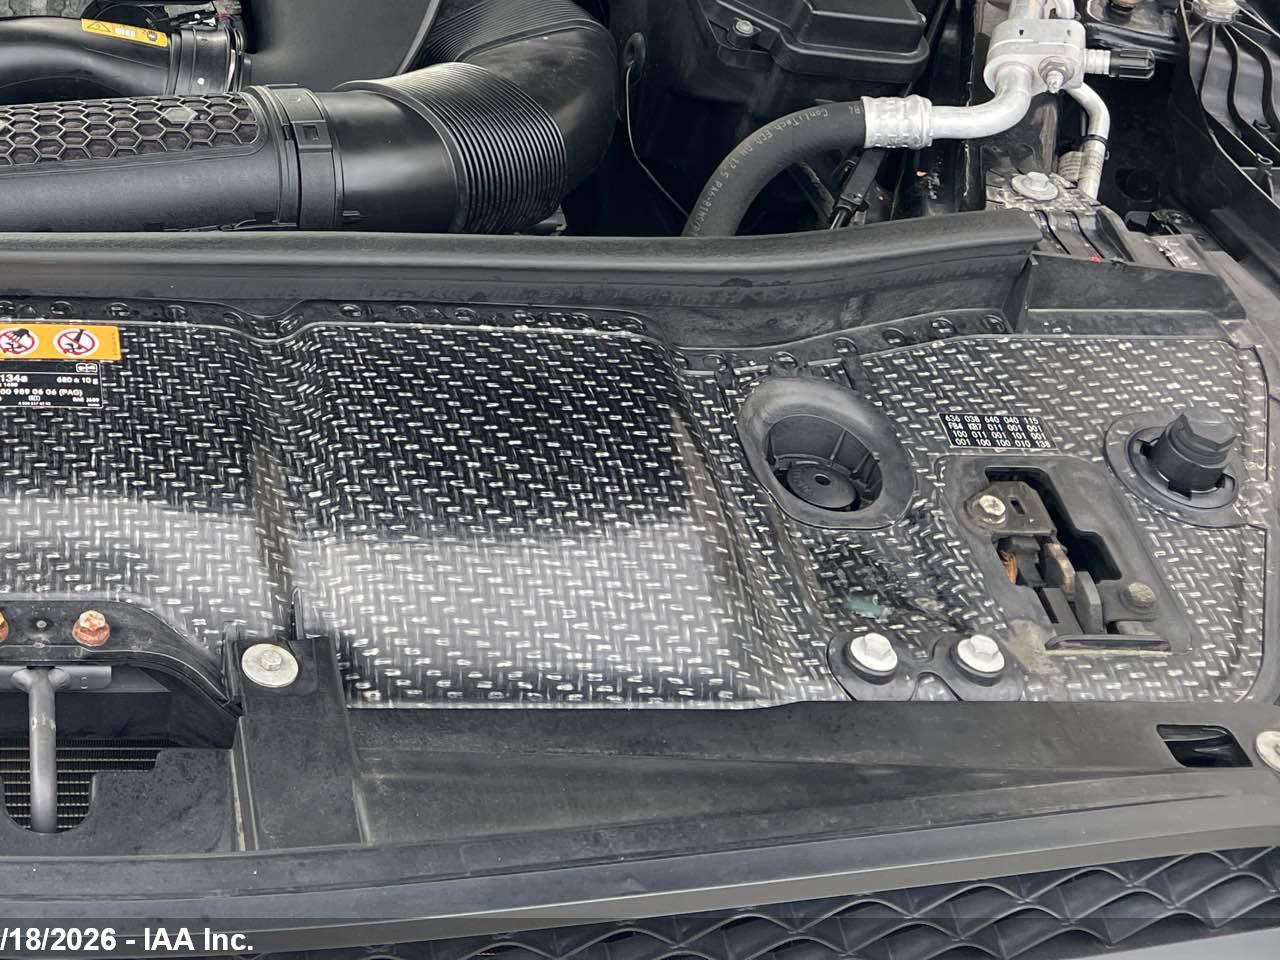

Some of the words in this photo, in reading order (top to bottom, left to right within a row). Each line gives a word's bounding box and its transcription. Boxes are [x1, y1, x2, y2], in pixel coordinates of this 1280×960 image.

[58, 388, 83, 397] (PAG)
[952, 430, 967, 438] 100
[1030, 432, 1046, 440] 001
